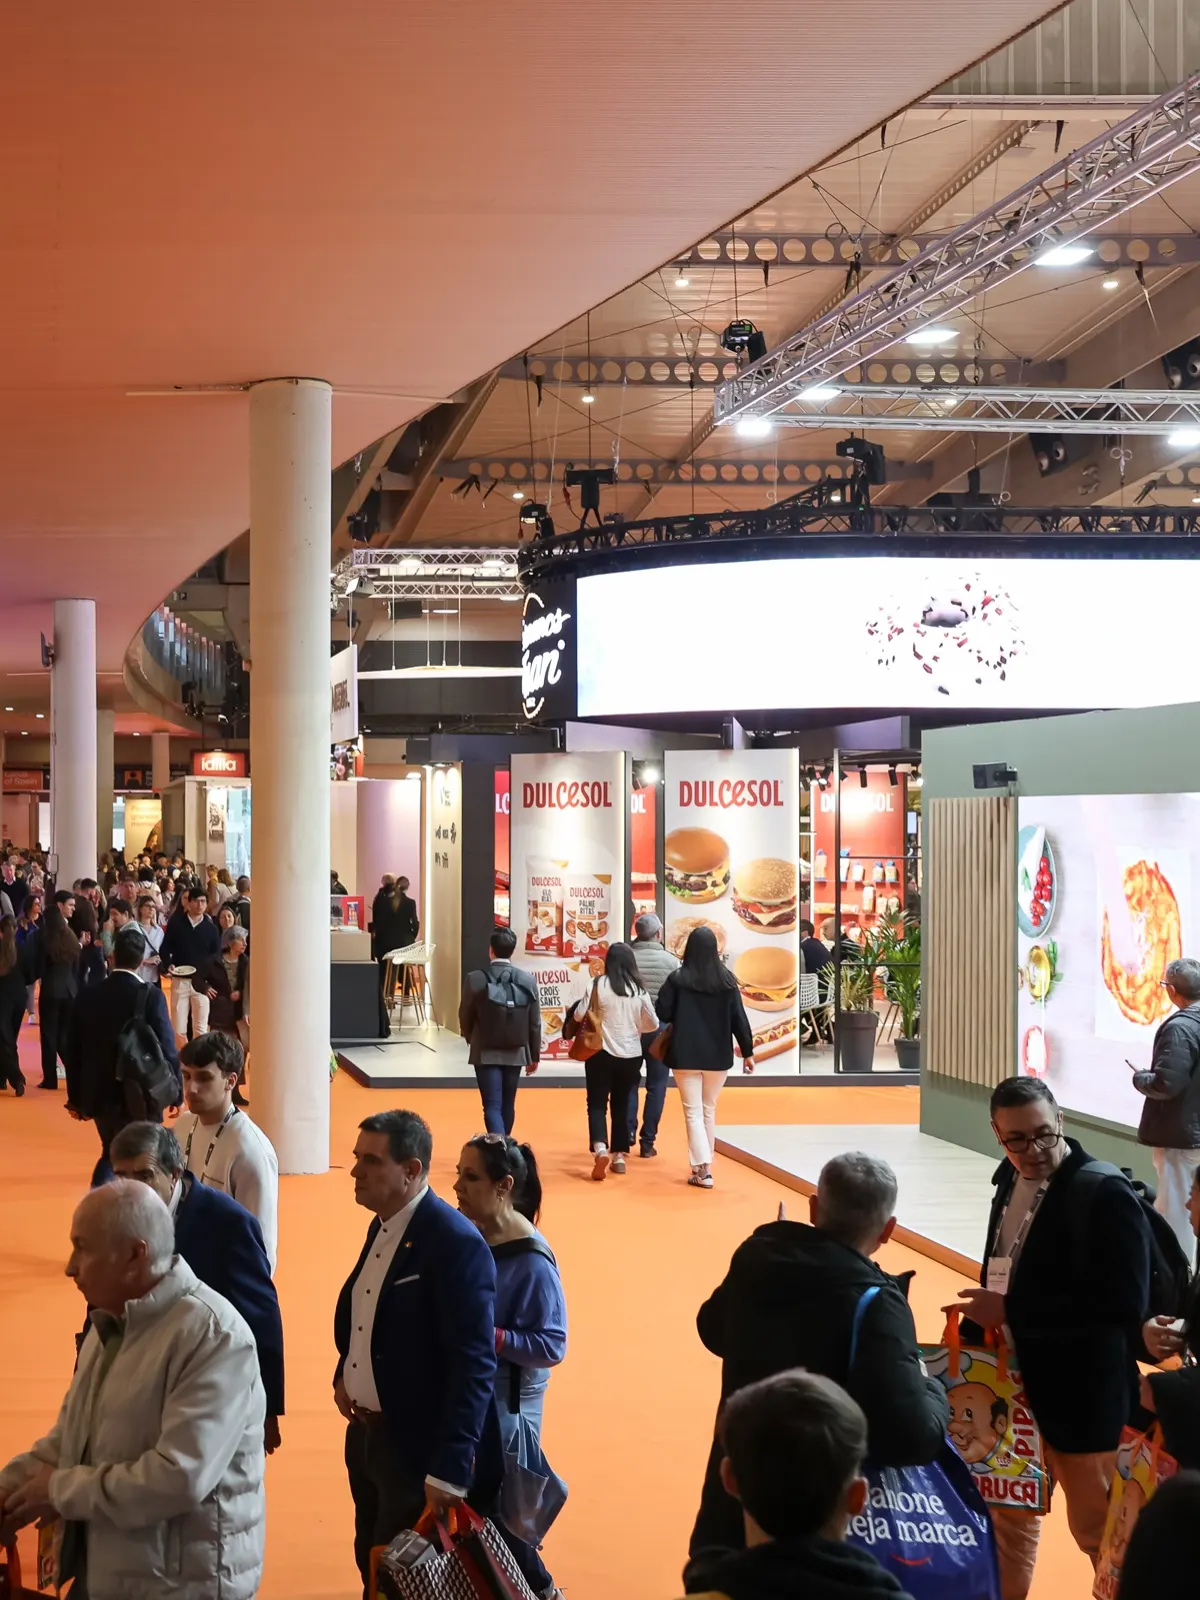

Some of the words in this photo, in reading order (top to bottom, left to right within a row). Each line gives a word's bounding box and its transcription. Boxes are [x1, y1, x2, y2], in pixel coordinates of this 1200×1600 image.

[540, 996, 561, 1007] SANTS
[864, 1486, 947, 1516] anone
[974, 1475, 1037, 1504] RUCA
[895, 1519, 979, 1547] marca
